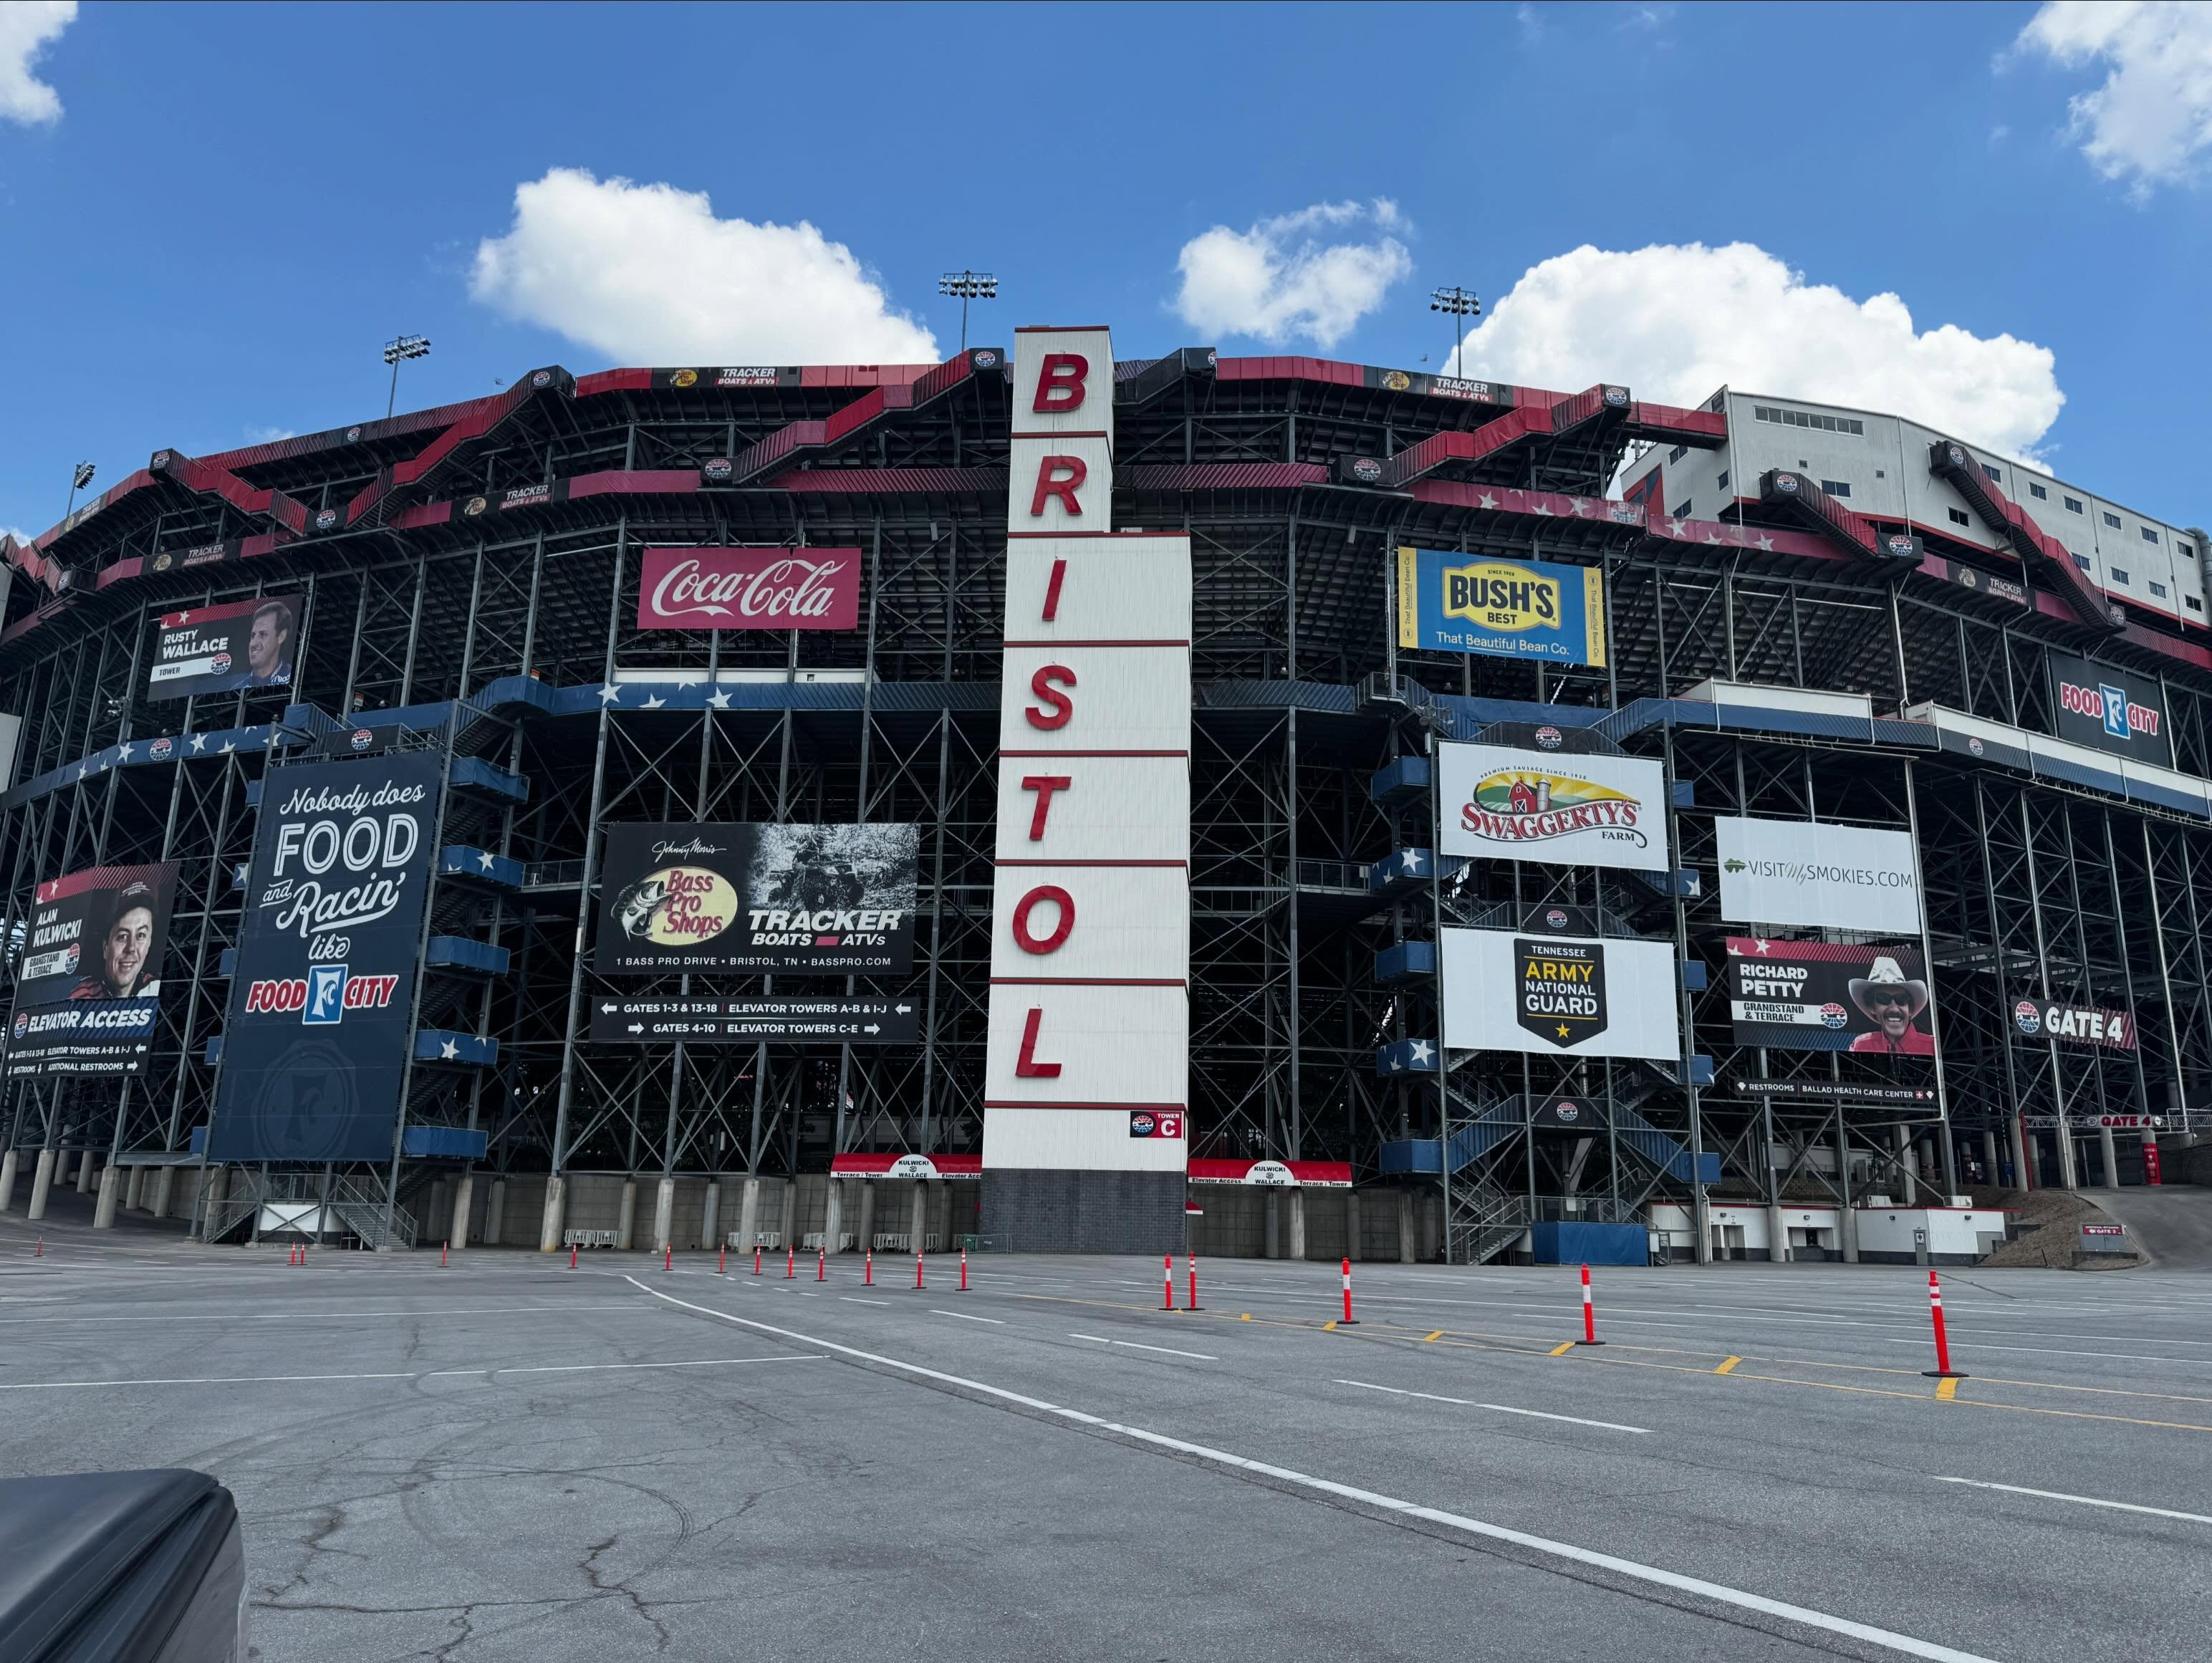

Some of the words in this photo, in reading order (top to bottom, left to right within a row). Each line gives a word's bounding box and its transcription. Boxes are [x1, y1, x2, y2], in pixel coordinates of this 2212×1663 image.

[722, 368, 776, 377] TRACKER
[1436, 377, 1489, 393] TRACKER
[1433, 388, 1461, 397] BOATS
[1468, 392, 1489, 402] ATVs
[507, 484, 549, 500] TRACKER
[502, 498, 524, 508] BOATS
[529, 496, 548, 504] ATVs
[188, 544, 223, 558] TRACKER
[652, 559, 848, 617] Coca-Cola
[1990, 577, 2022, 595] TRACKER
[1450, 574, 1554, 619] BUSH'S
[1487, 612, 1517, 625] BEST
[164, 629, 198, 645] RUSTY
[1436, 632, 1463, 645] That
[1466, 634, 1516, 651] Beautiful
[1519, 640, 1547, 652] Bean
[1551, 643, 1570, 655] Co.
[163, 637, 229, 660] WALLACE
[159, 666, 181, 676] TOWER
[1012, 353, 1090, 1077] BRISTOL
[2060, 682, 2104, 719] FOOD
[2126, 702, 2158, 736] CITY
[1480, 766, 1510, 779] PREMIUM
[279, 784, 371, 816] Nobody
[372, 780, 425, 806] does
[1461, 799, 1638, 840] SWAGGERTY'S
[1602, 830, 1635, 842] FARM
[273, 813, 419, 877] FOOD
[652, 841, 689, 863] Johnny
[681, 837, 726, 854] Morris
[665, 870, 714, 893] Bass
[261, 879, 294, 907] and
[275, 872, 406, 937] Racin'
[665, 892, 701, 912] Pro
[37, 908, 57, 927] ALAN
[663, 911, 723, 939] Shops
[748, 910, 902, 931] TRACKER
[33, 919, 82, 948] KULWICKI
[751, 933, 812, 946] BOATS
[841, 933, 886, 945] ATVs
[308, 933, 350, 960] like
[1531, 945, 1586, 957] TENNESSEE
[29, 953, 59, 968] GRANDSTAND
[683, 957, 716, 965] DRIVE
[730, 958, 780, 967] BRISTOL,
[811, 958, 891, 966] BASSPRO.COM
[33, 964, 52, 976] TERRACE
[1526, 961, 1594, 983] ARMY
[1740, 963, 1808, 980] RICHARD
[246, 979, 308, 1013] FOOD
[344, 975, 399, 1009] CITY
[1526, 980, 1596, 996] NATIONAL
[1741, 979, 1804, 998] PETTY
[623, 1003, 660, 1013] GATES
[663, 1003, 678, 1013] 1-3
[680, 1004, 688, 1013] &
[691, 1003, 718, 1013] 13-18
[728, 1004, 787, 1013] ELEVATOR
[789, 1004, 837, 1013] TOWERS
[840, 1004, 860, 1013] A-B
[863, 1004, 872, 1013] &
[873, 1004, 888, 1013] I-J
[1526, 994, 1597, 1015] GUARD
[1744, 1003, 1804, 1013] GRANDSTAND
[28, 1011, 80, 1033] ELEVATOR
[80, 1008, 153, 1028] ACCESS
[1756, 1011, 1794, 1022] TERRACE
[2045, 1006, 2103, 1039] GATE
[2107, 1016, 2123, 1042] 4
[653, 1023, 690, 1033] GATES
[692, 1023, 716, 1033] 4-10
[727, 1024, 785, 1033] ELEVATOR
[788, 1024, 837, 1033] TOWERS
[839, 1024, 858, 1033] C-E
[47, 1046, 68, 1055] ELEVATOR
[13, 1065, 35, 1074] RESTROOMS
[47, 1062, 79, 1071] ADDITIONAL
[80, 1062, 123, 1071] RESTROOMS
[1749, 1084, 1794, 1092] RESTROOMS
[1802, 1085, 1832, 1094] BALLAD
[1834, 1086, 1862, 1095] HEALTH
[1863, 1088, 1883, 1096] CARE
[1160, 1119, 1175, 1136] C
[2101, 1116, 2138, 1127] GATE
[2142, 1116, 2151, 1127] 4
